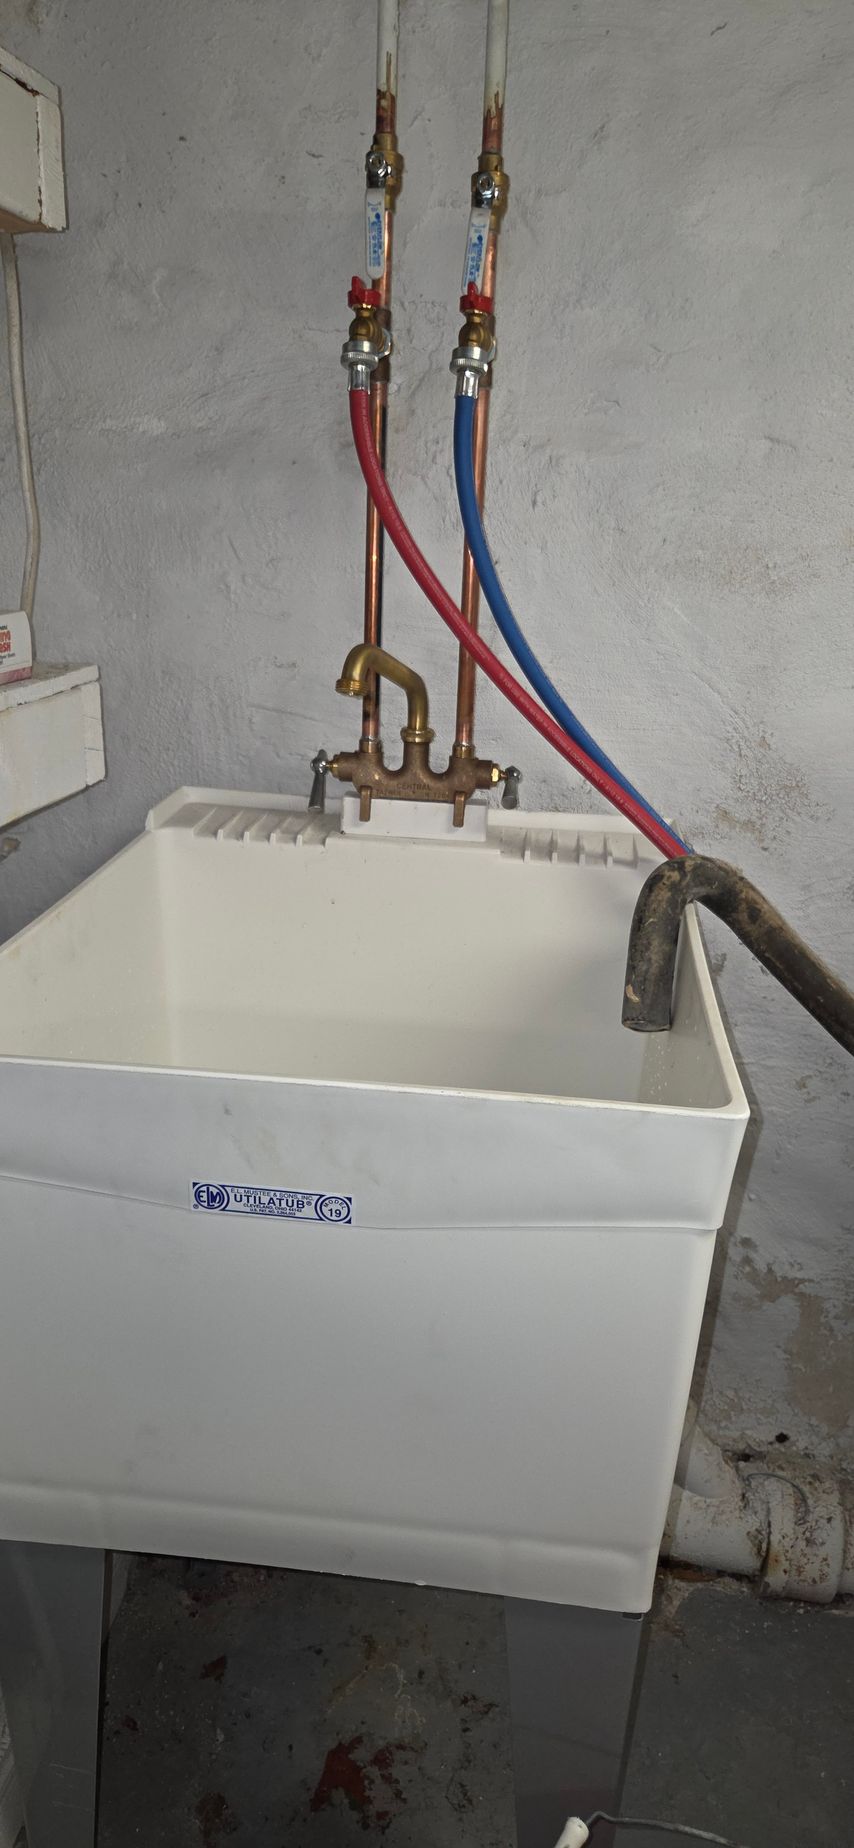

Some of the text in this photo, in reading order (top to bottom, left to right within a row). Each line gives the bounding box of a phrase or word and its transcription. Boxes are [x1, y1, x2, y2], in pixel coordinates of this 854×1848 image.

[396, 783, 432, 791] CENTRAL
[323, 1200, 346, 1210] MODEL
[328, 1208, 341, 1218] 19
